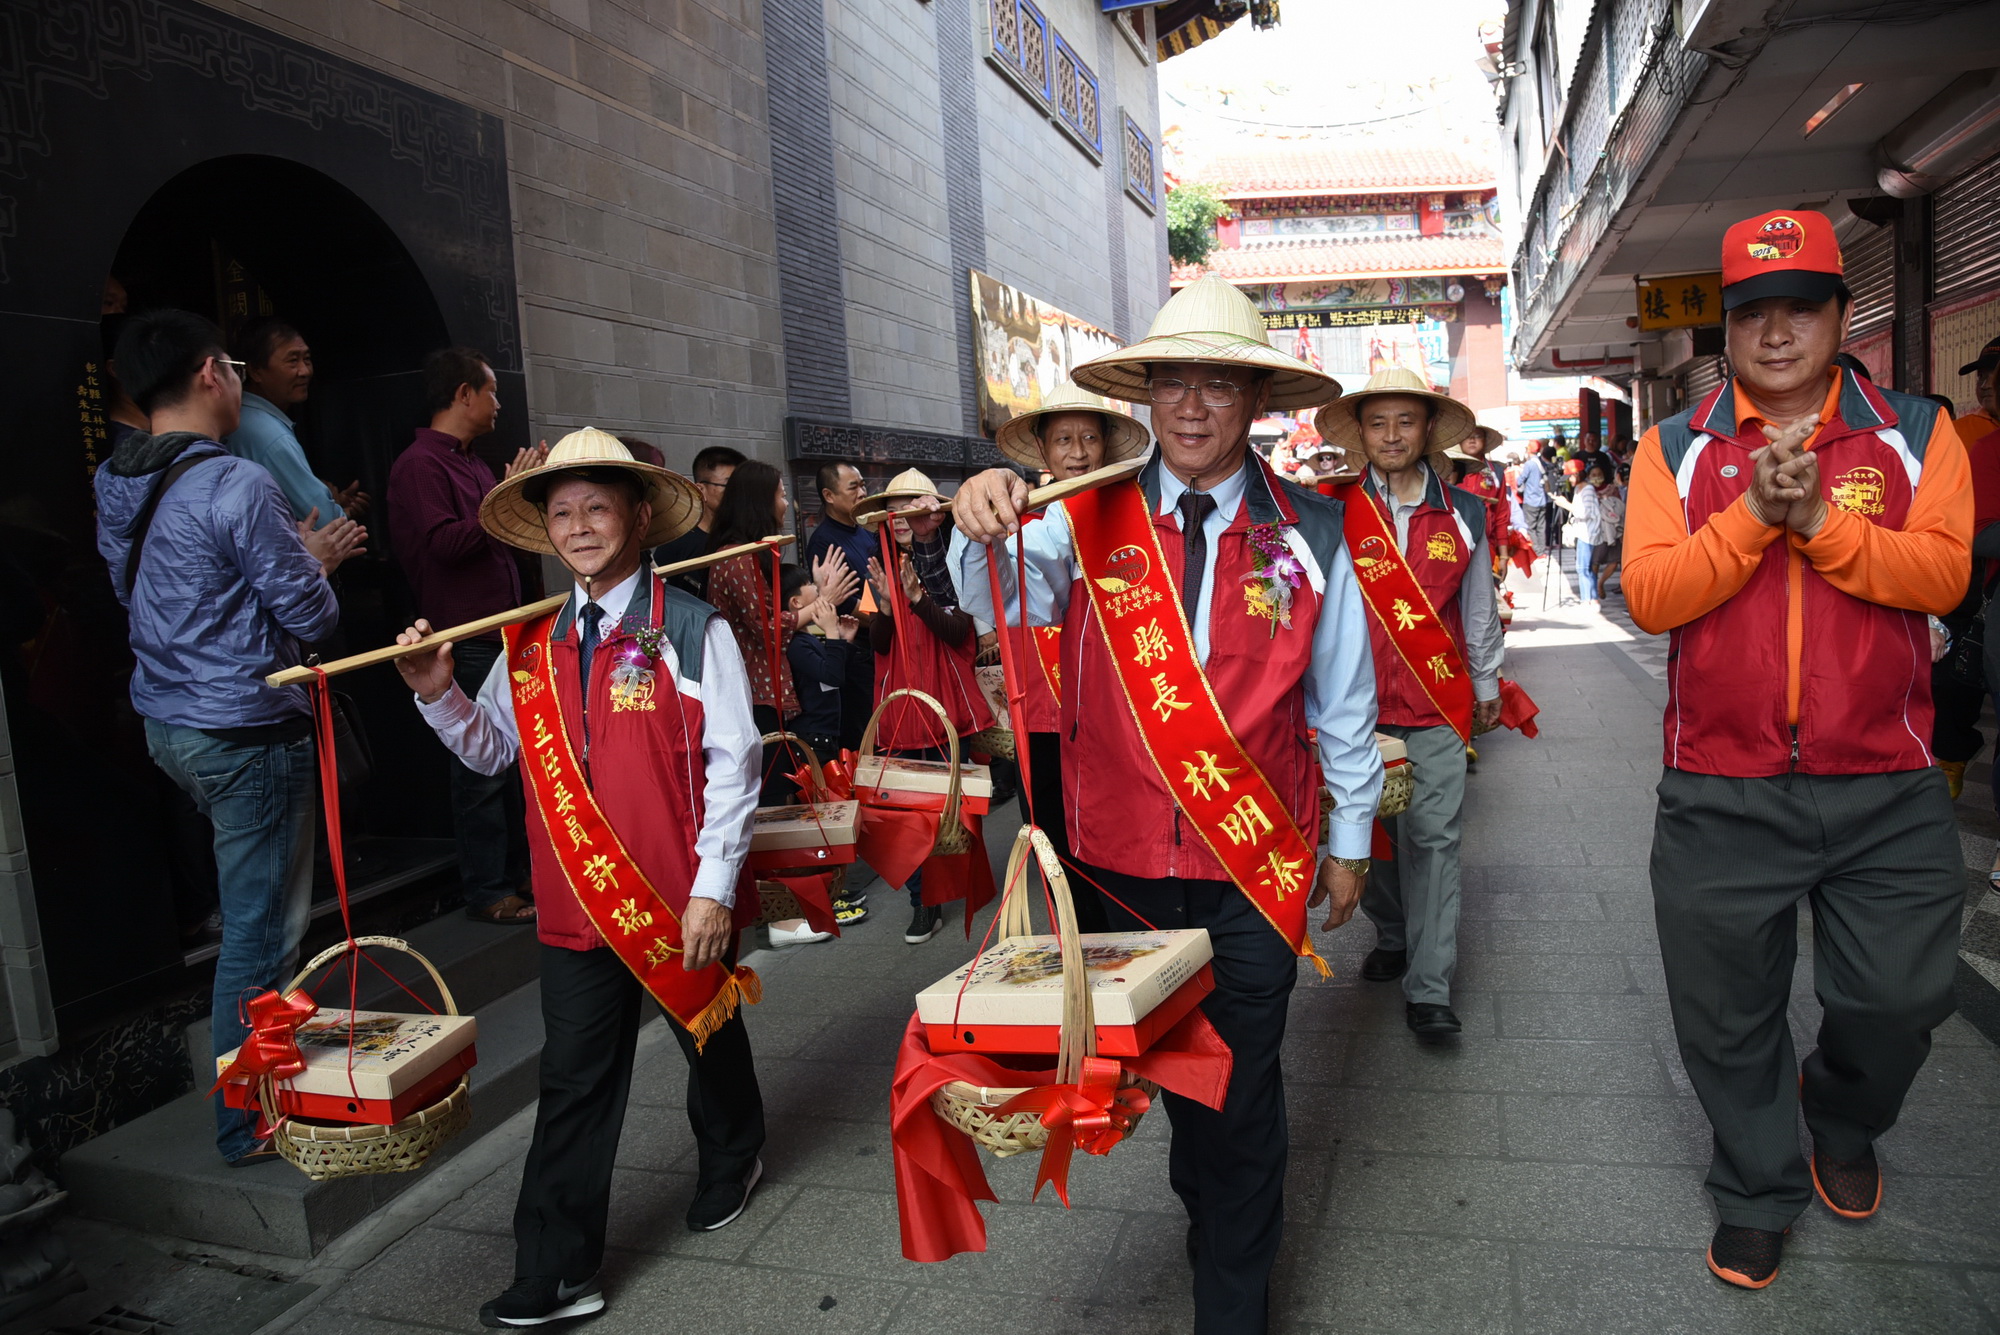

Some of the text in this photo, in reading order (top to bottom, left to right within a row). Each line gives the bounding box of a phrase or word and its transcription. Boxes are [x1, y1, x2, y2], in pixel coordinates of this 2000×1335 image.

[1752, 245, 1772, 258] 2018
[1645, 284, 1723, 319] 接待
[1114, 592, 1163, 619] 萬人吃平安
[1392, 598, 1455, 685] 來賓
[1132, 617, 1304, 902] 縣長 林明溱
[533, 713, 593, 852] 主任委員
[836, 907, 864, 920] FILA
